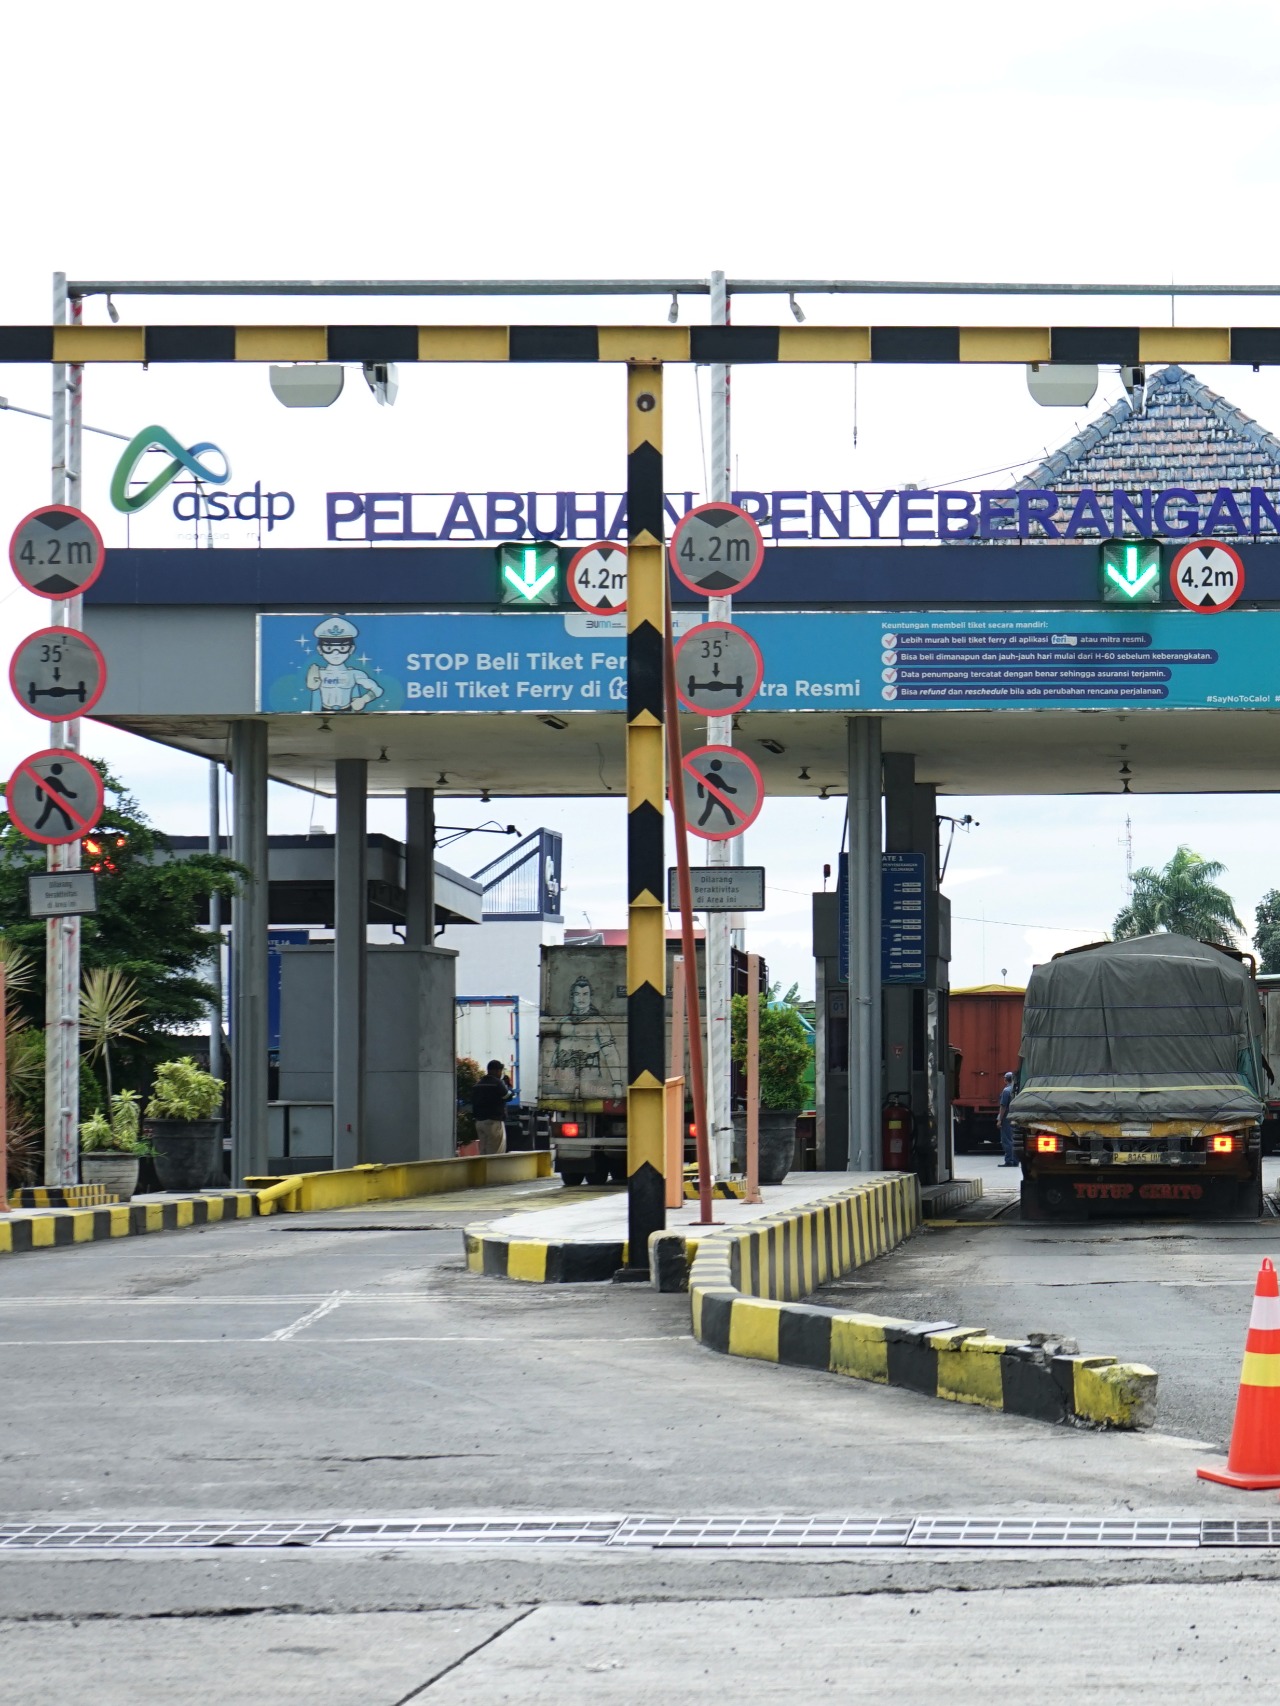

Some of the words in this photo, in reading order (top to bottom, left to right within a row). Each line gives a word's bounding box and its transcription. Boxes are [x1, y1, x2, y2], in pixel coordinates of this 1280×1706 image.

[173, 480, 295, 532] asdp
[20, 539, 93, 565] 4.2m
[680, 536, 750, 562] 4.2m
[578, 568, 628, 590] 4.2m
[1180, 565, 1234, 590] 4.2m
[882, 622, 930, 630] Keuntungan
[988, 636, 1007, 644] ferry
[1018, 636, 1048, 644] aplikasi
[41, 644, 62, 663] 35
[701, 640, 722, 659] 35
[936, 653, 980, 661] dimanapun
[998, 653, 1035, 661] jauh-jauh
[1117, 652, 1150, 660] sebelum
[1152, 652, 1212, 661] keberangkatan.
[406, 654, 469, 671] STOP
[476, 652, 518, 670] Beli
[526, 652, 584, 670] Tiket
[591, 652, 628, 670] Fer
[1004, 671, 1033, 679] dengan
[1060, 670, 1095, 678] sehingga
[1132, 670, 1166, 678] terjamin.
[406, 681, 448, 698] Beli
[454, 681, 510, 698] Tiket
[516, 681, 574, 702] Ferry
[581, 680, 600, 698] di
[755, 680, 788, 697] tra
[795, 680, 861, 697] Resmi
[1043, 688, 1085, 696] perubahan
[1120, 688, 1164, 696] perjalanan.
[1206, 694, 1270, 704] #SayNoToCalo!
[701, 876, 733, 884] Dilarang
[1073, 1183, 1133, 1198] TUTUP
